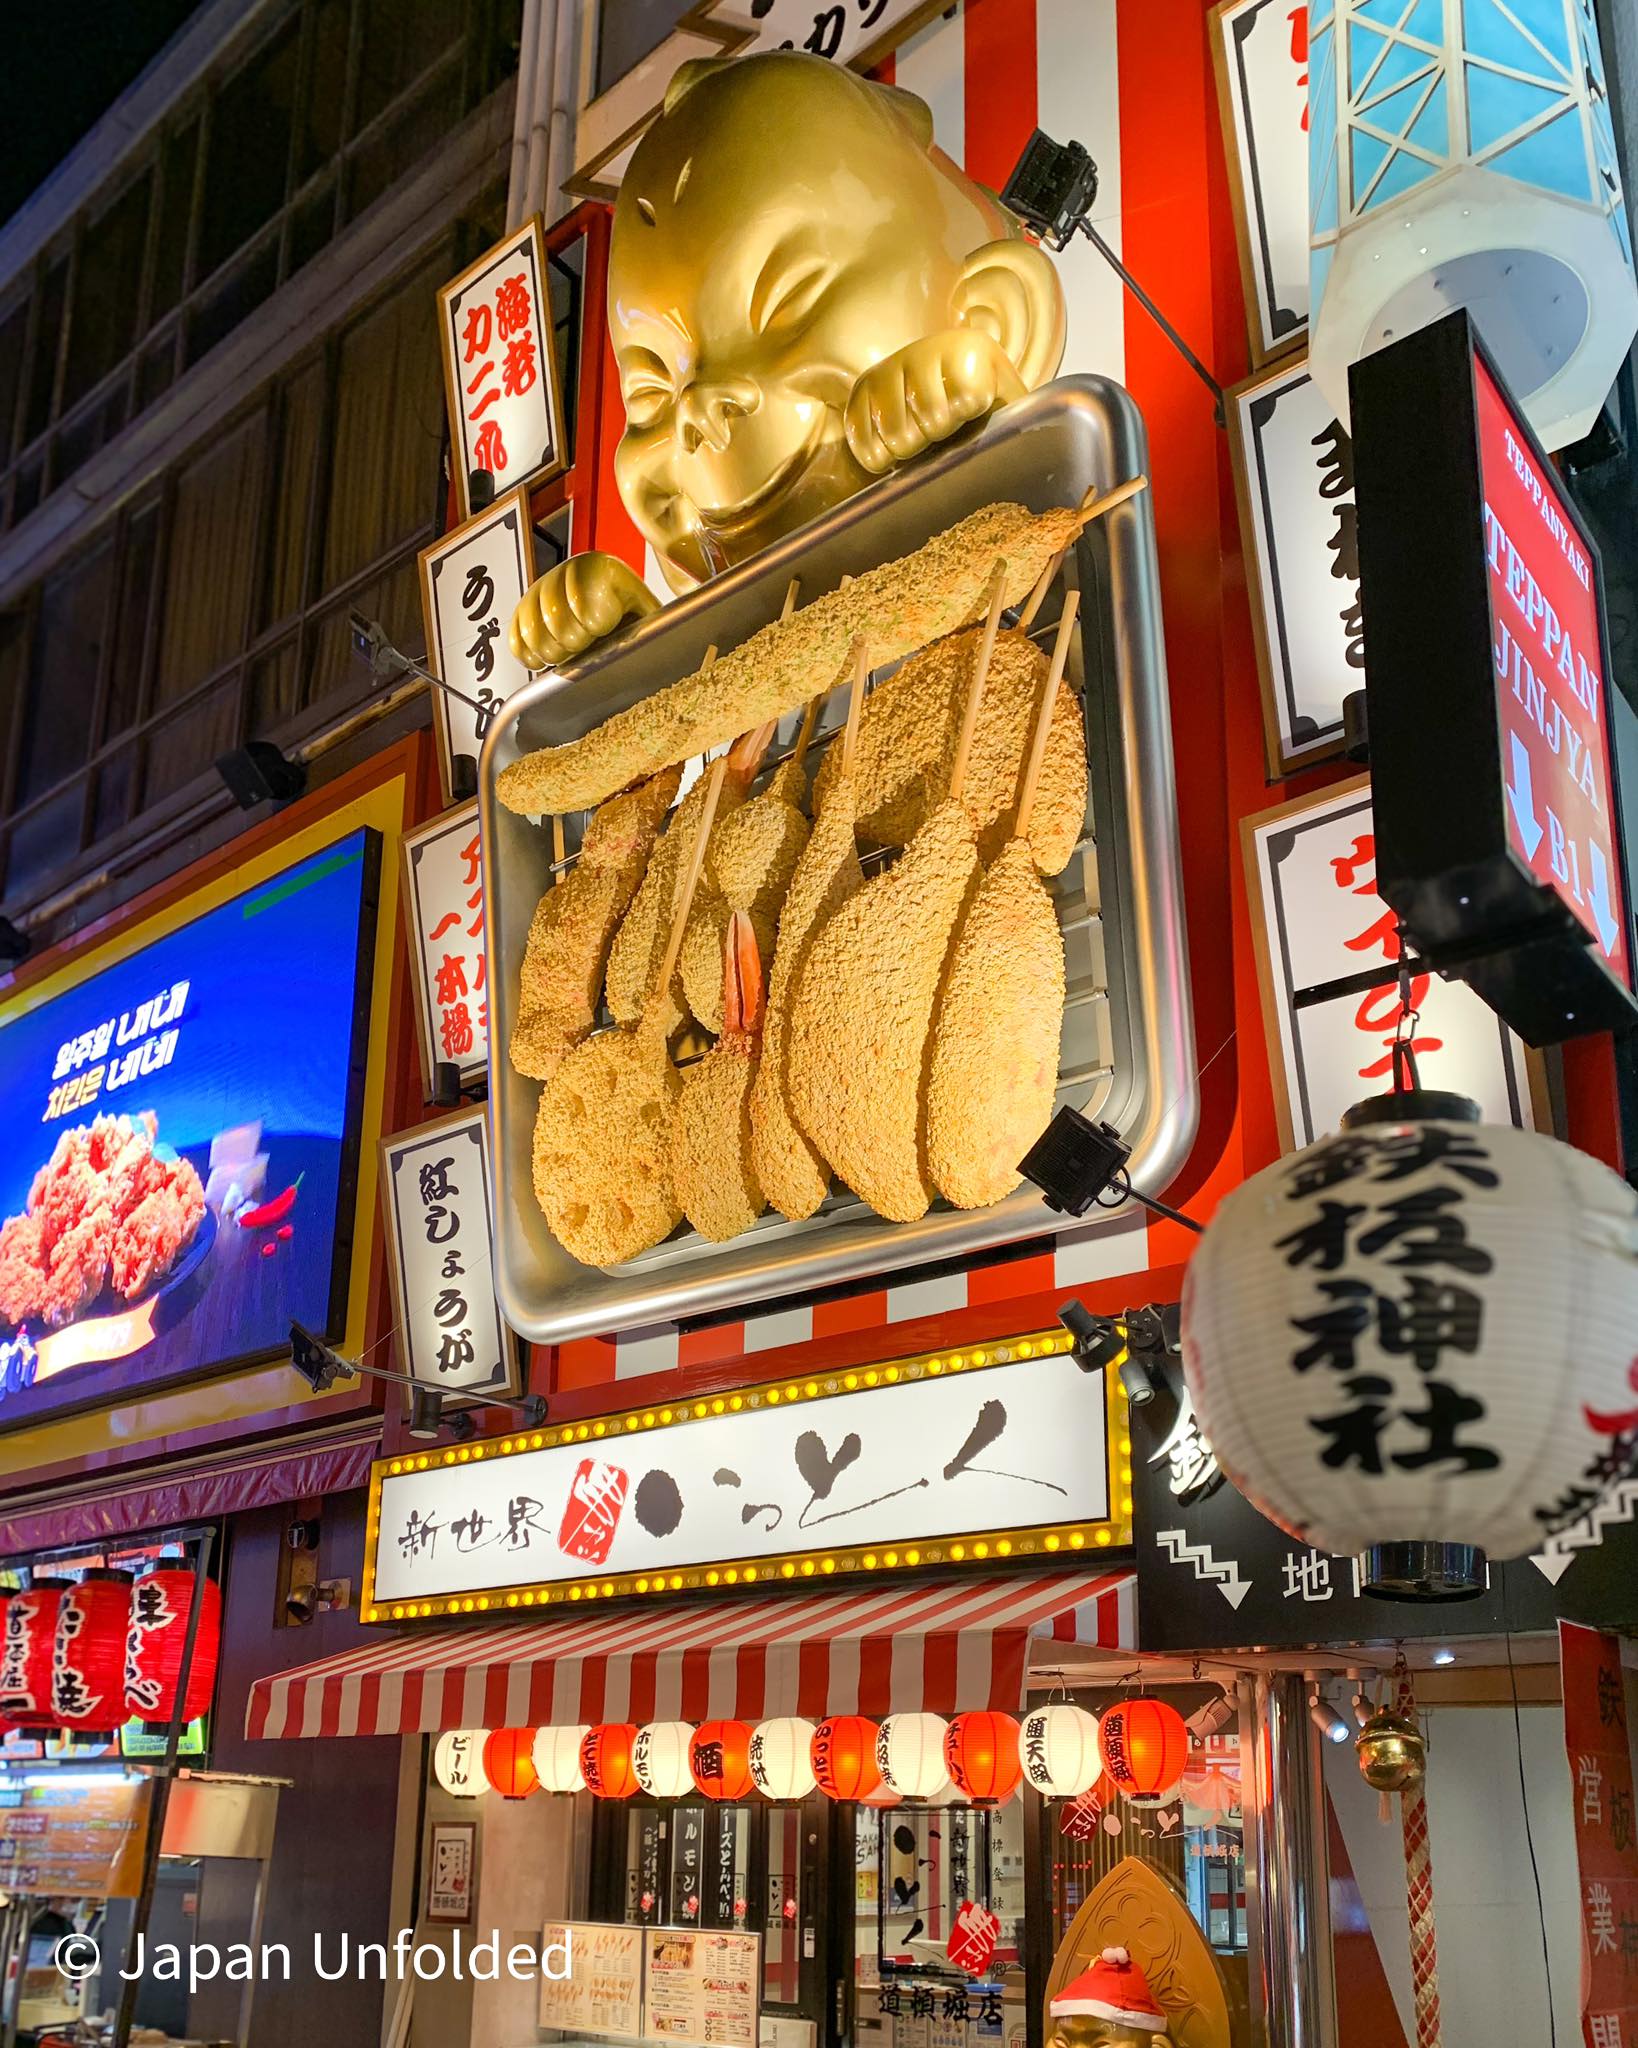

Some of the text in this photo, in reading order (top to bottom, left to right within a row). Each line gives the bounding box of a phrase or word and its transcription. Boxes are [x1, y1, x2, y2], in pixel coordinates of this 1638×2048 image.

[496, 273, 537, 397] 海老
[1503, 429, 1590, 593] TEPPANYAKI
[1484, 500, 1599, 723] TEPPAN
[1495, 620, 1600, 812] JINJYA
[1546, 804, 1586, 908] B1
[52, 1018, 116, 1080] 일주일
[42, 1065, 105, 1122] 치킨은
[419, 1157, 475, 1373] 紅しょうが
[398, 1496, 551, 1568] 新世界
[450, 1735, 471, 1785] ビール
[582, 1732, 602, 1790] どて焼き
[634, 1731, 653, 1790] ホルモン
[693, 1740, 724, 1781] 酒
[750, 1734, 770, 1787] 焼酎
[1026, 1716, 1053, 1785] 通天閣
[879, 1983, 1004, 2026] 道頓堀店
